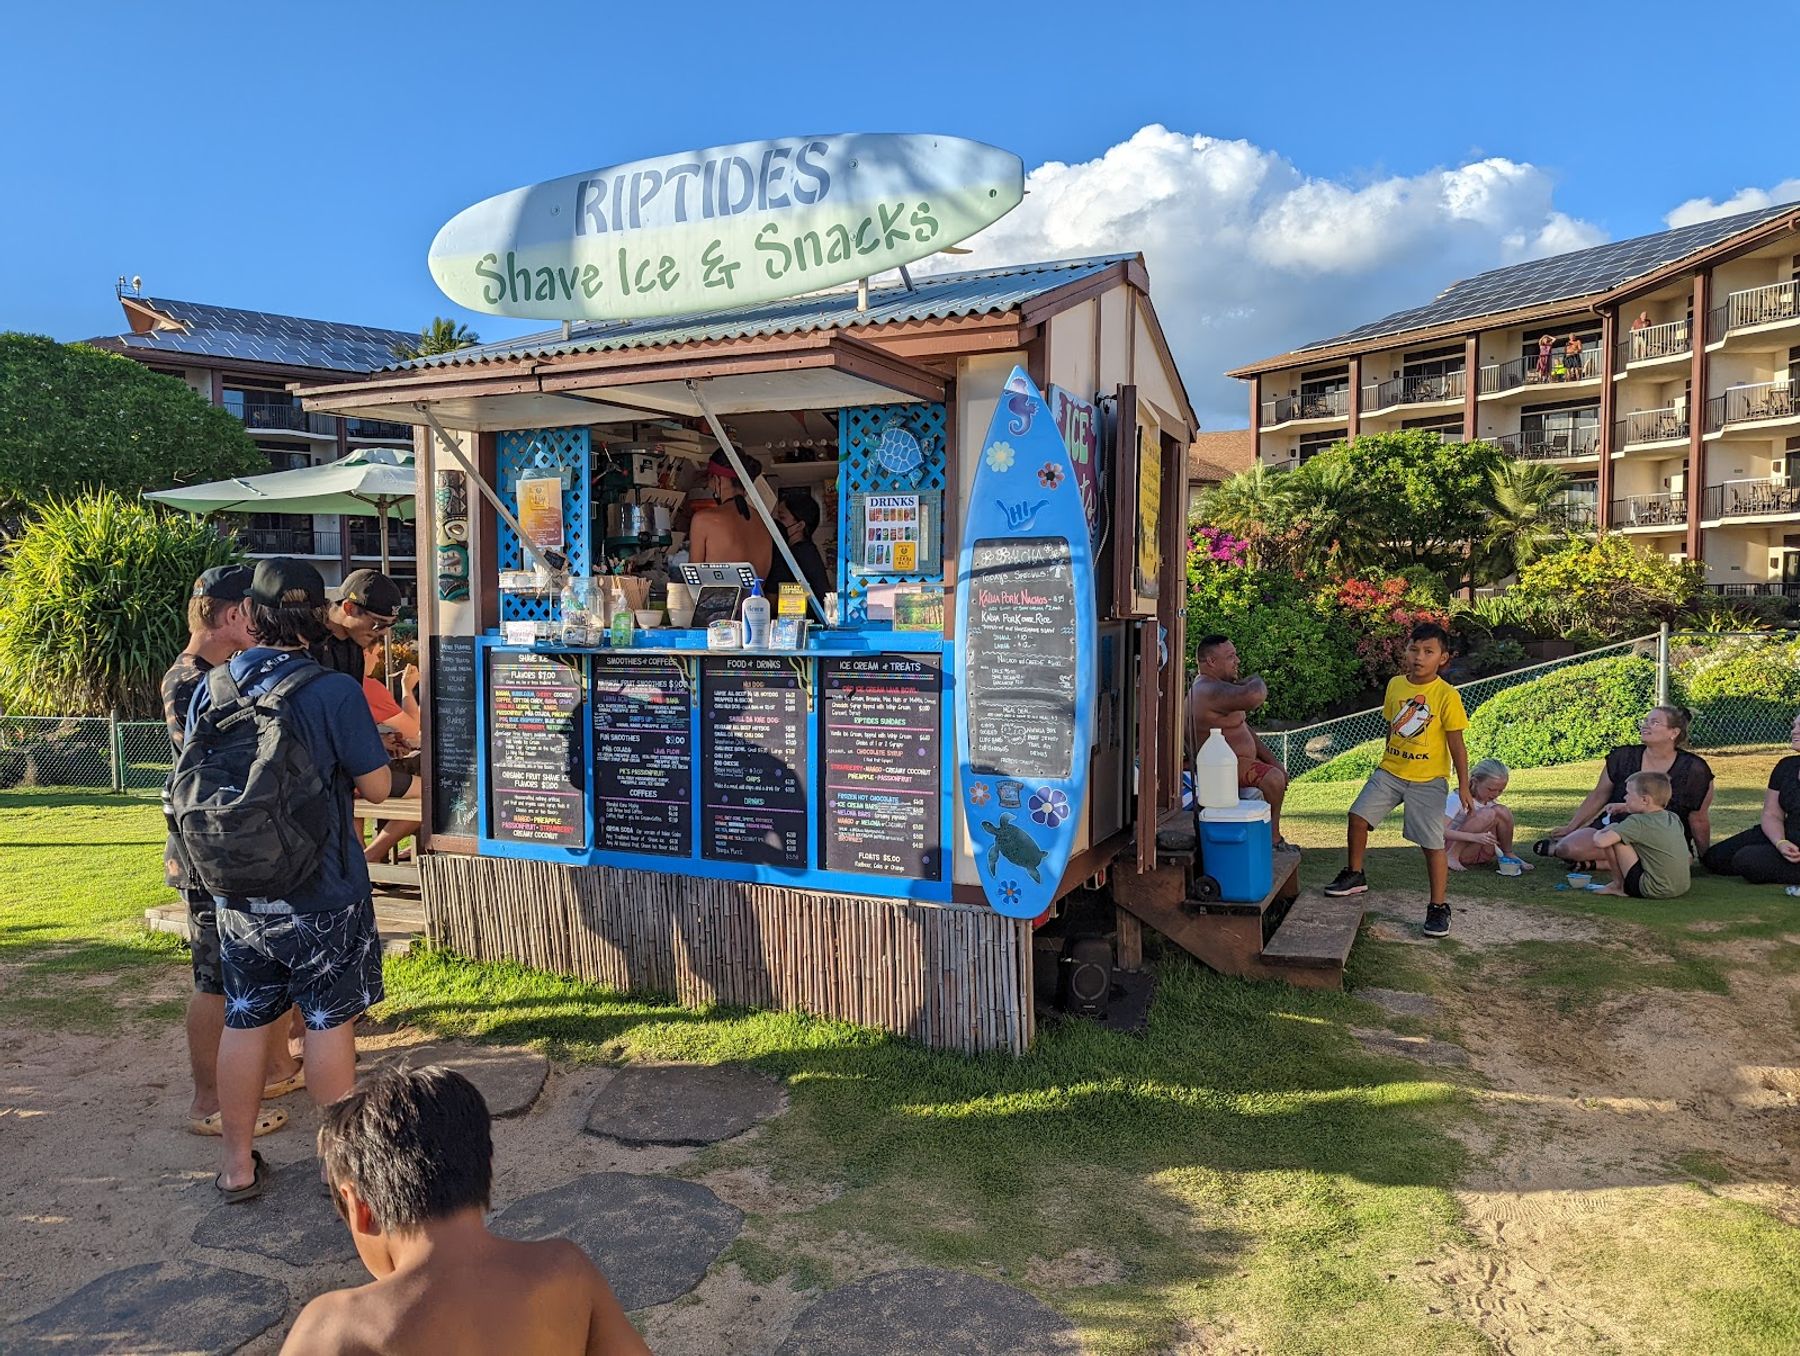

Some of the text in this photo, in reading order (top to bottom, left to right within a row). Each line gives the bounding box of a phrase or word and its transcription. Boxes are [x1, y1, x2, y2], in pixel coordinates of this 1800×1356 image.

[575, 142, 831, 237] RIPTIDES
[476, 202, 939, 305] Shave Ice & Snacks
[1065, 404, 1089, 464] ICE
[870, 497, 914, 506] DRINKS
[1001, 591, 1020, 605] PORK
[1021, 589, 1048, 605] NACHOS
[1002, 613, 1021, 625] PORK
[518, 654, 537, 662] SHAVE
[607, 657, 642, 665] SMOOTHIES
[727, 660, 747, 668] FOOD
[757, 660, 781, 668] DRINKS
[840, 661, 850, 670] ICE
[853, 661, 879, 670] CREAM
[890, 662, 921, 671] TREATS
[511, 671, 535, 679] FLAVORS
[1385, 746, 1429, 760] AID BACK
[502, 771, 524, 779] ORGANIC
[515, 780, 538, 788] FLAVORS
[629, 789, 658, 797] COFFEES
[533, 816, 561, 824] PINEAPPLE
[534, 831, 558, 839] COCONUT
[859, 852, 880, 860] FLOATS
